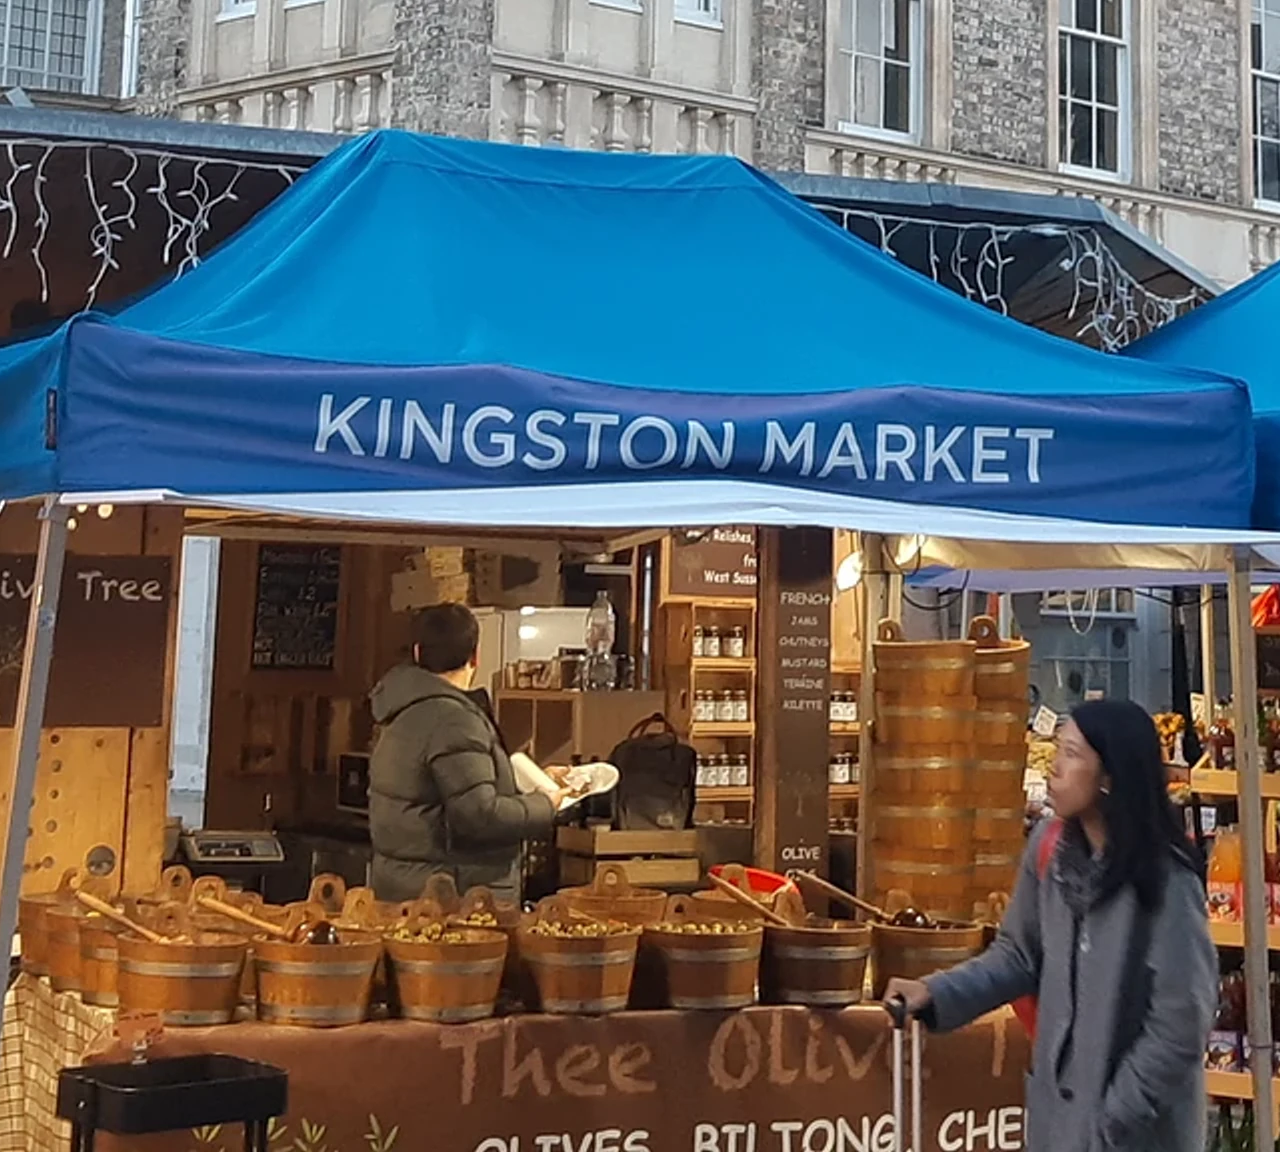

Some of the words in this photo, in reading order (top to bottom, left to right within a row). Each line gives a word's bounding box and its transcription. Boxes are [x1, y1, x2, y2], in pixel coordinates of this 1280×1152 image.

[313, 393, 734, 471] KINGSTON
[758, 420, 1055, 484] MARKET
[704, 569, 731, 584] West
[77, 570, 163, 601] Tree
[780, 591, 831, 606] FRENCH
[790, 615, 819, 626] JAMS
[781, 657, 828, 669] MUSTARD
[781, 845, 821, 861] OLIVE
[438, 1016, 658, 1107] Thee
[937, 1106, 1027, 1151] CHE
